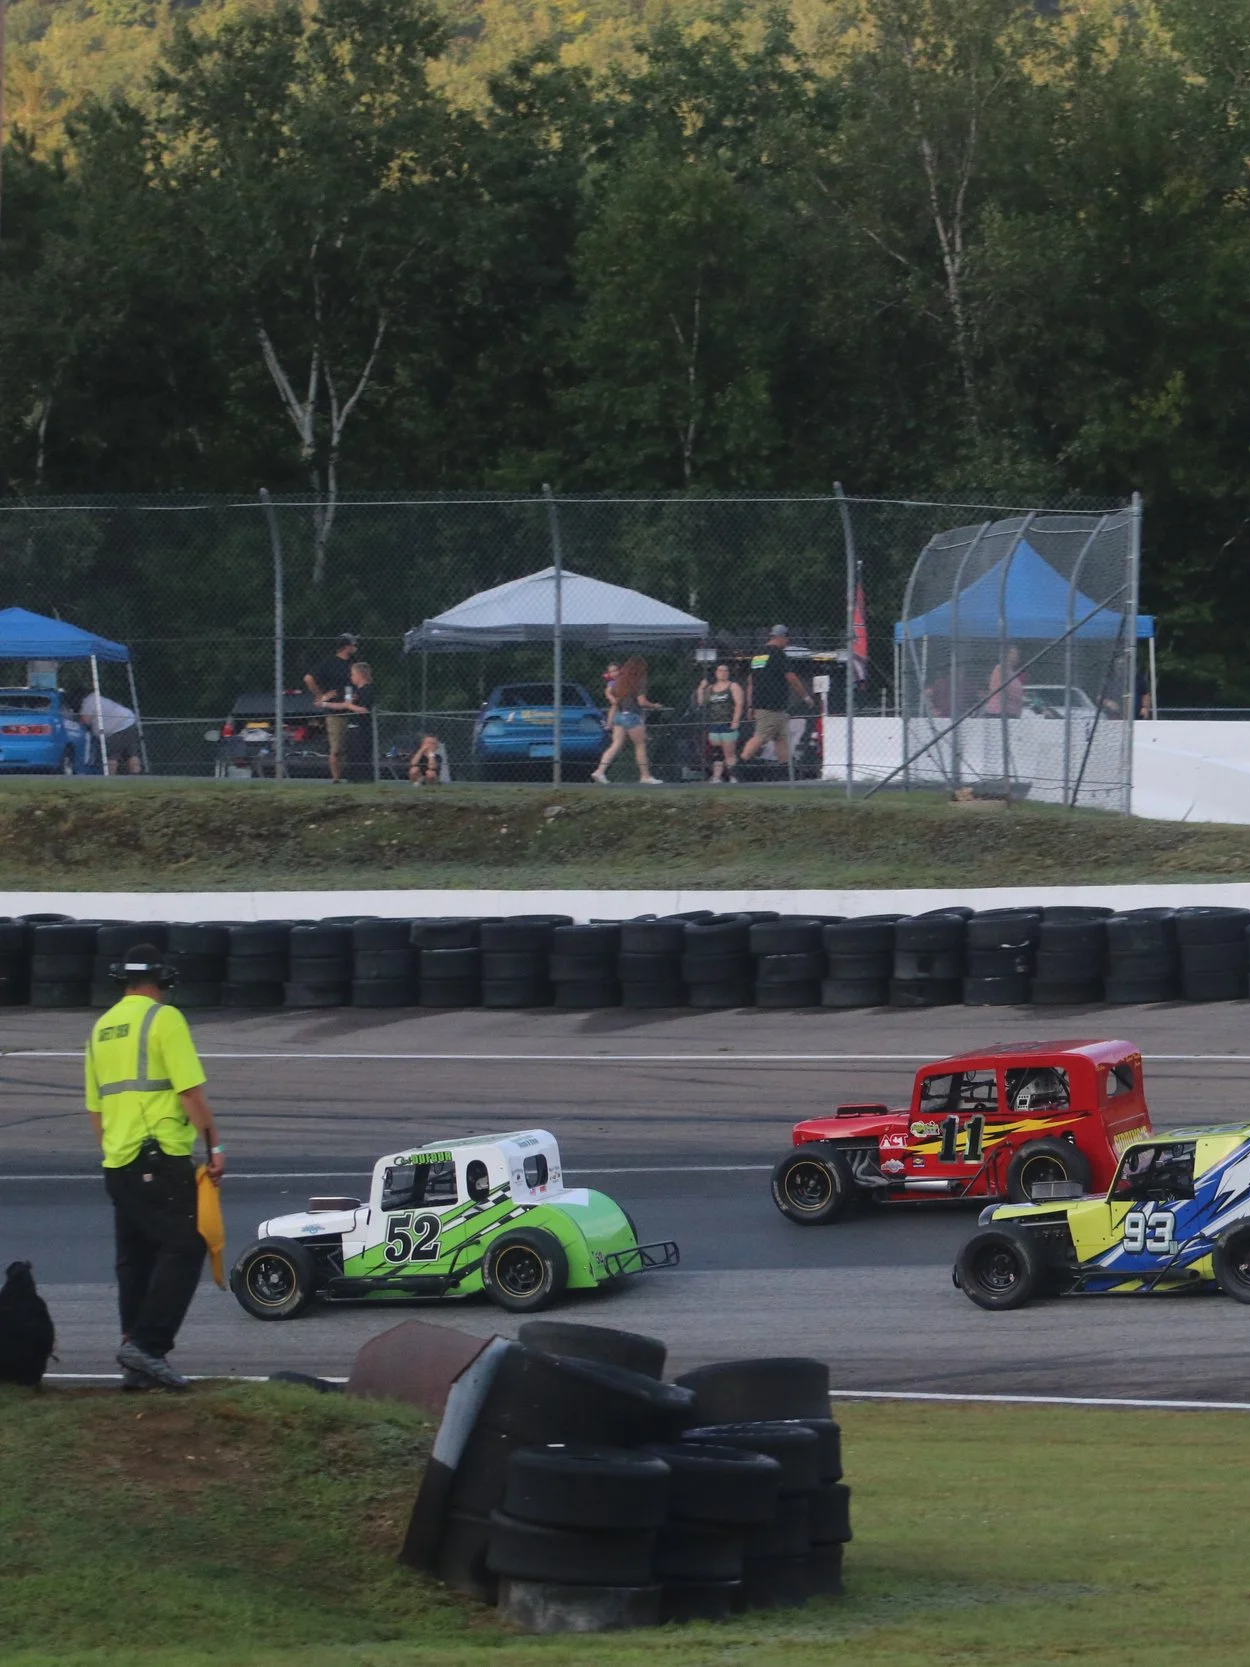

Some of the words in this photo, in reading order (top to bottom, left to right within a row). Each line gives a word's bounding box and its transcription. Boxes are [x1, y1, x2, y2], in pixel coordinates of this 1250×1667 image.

[938, 1114, 985, 1164] 11
[384, 1211, 442, 1264] 52
[1123, 1211, 1176, 1254] 93
